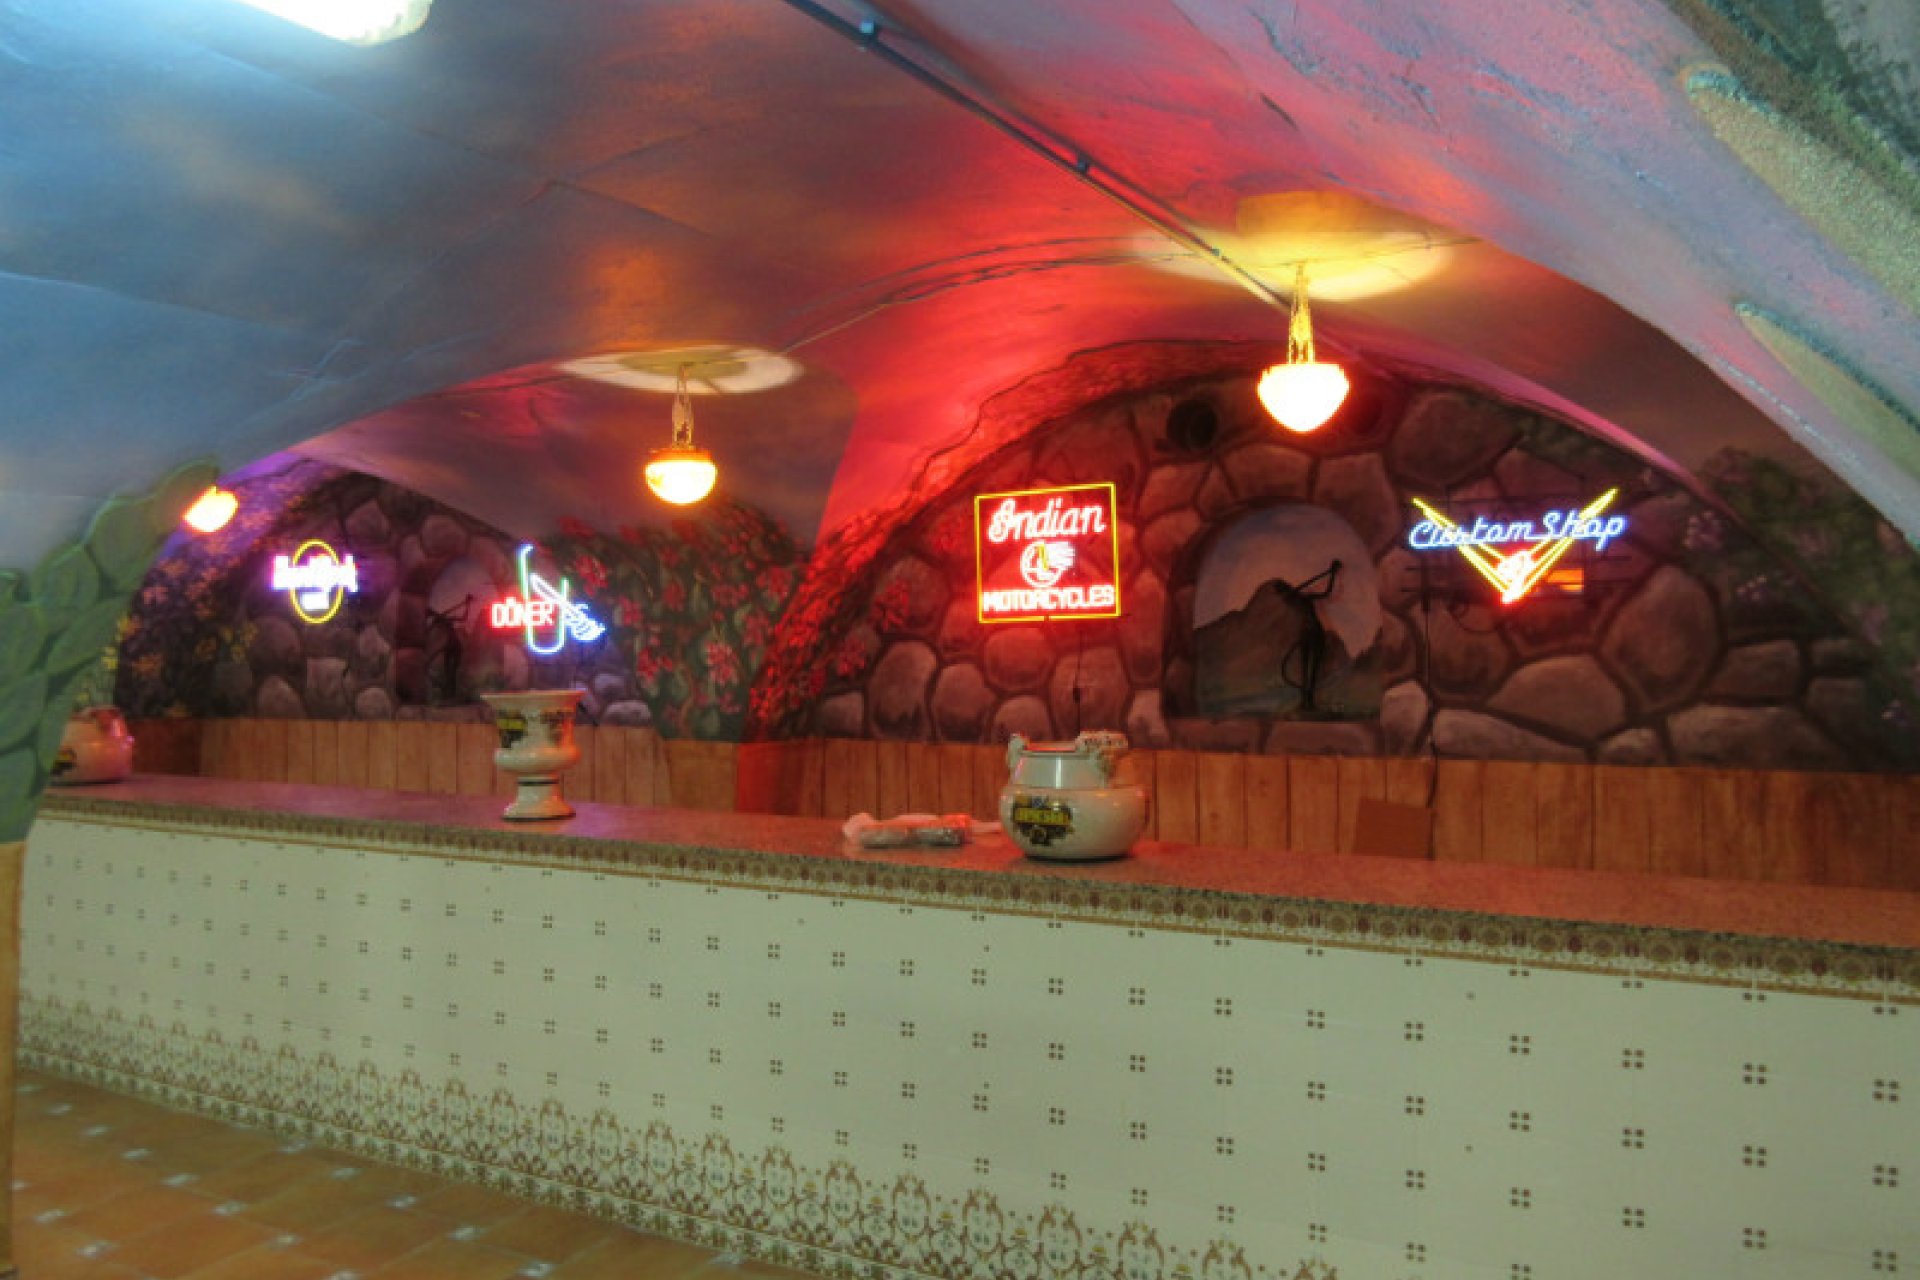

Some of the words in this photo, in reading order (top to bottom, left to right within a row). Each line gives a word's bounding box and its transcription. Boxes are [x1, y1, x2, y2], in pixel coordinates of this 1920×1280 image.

[988, 496, 1107, 544] Indian
[1408, 516, 1533, 550] Custom
[1541, 509, 1627, 552] Shop
[982, 584, 1115, 612] MOTORCYCLES
